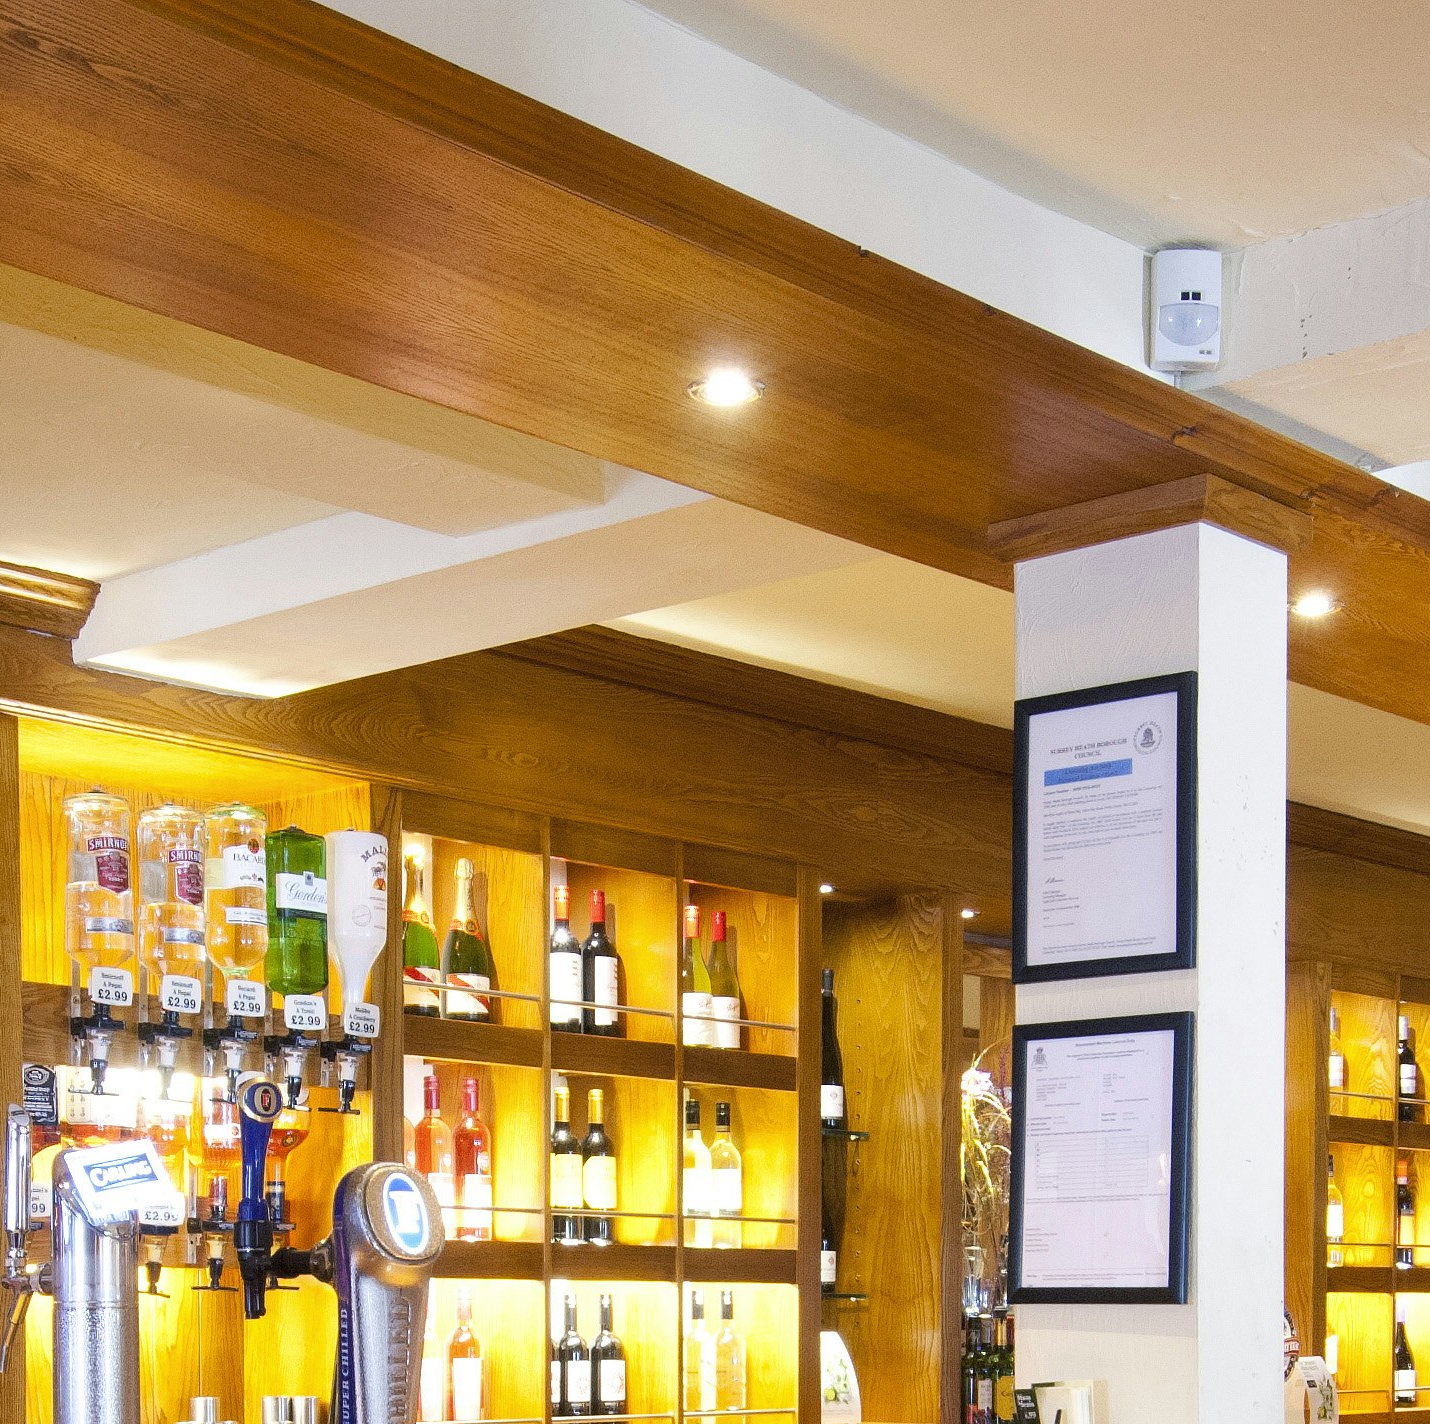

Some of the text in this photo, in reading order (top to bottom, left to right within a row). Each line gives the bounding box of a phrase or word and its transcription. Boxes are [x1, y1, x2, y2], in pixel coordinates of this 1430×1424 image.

[89, 838, 127, 851] SMIRNO
[98, 989, 128, 1001] £2.99
[167, 996, 196, 1009] £2.99
[233, 1001, 261, 1013] £2.99
[291, 1016, 321, 1026] £2.99
[349, 1021, 375, 1034] £2.99
[340, 1309, 349, 1377] CHILLED
